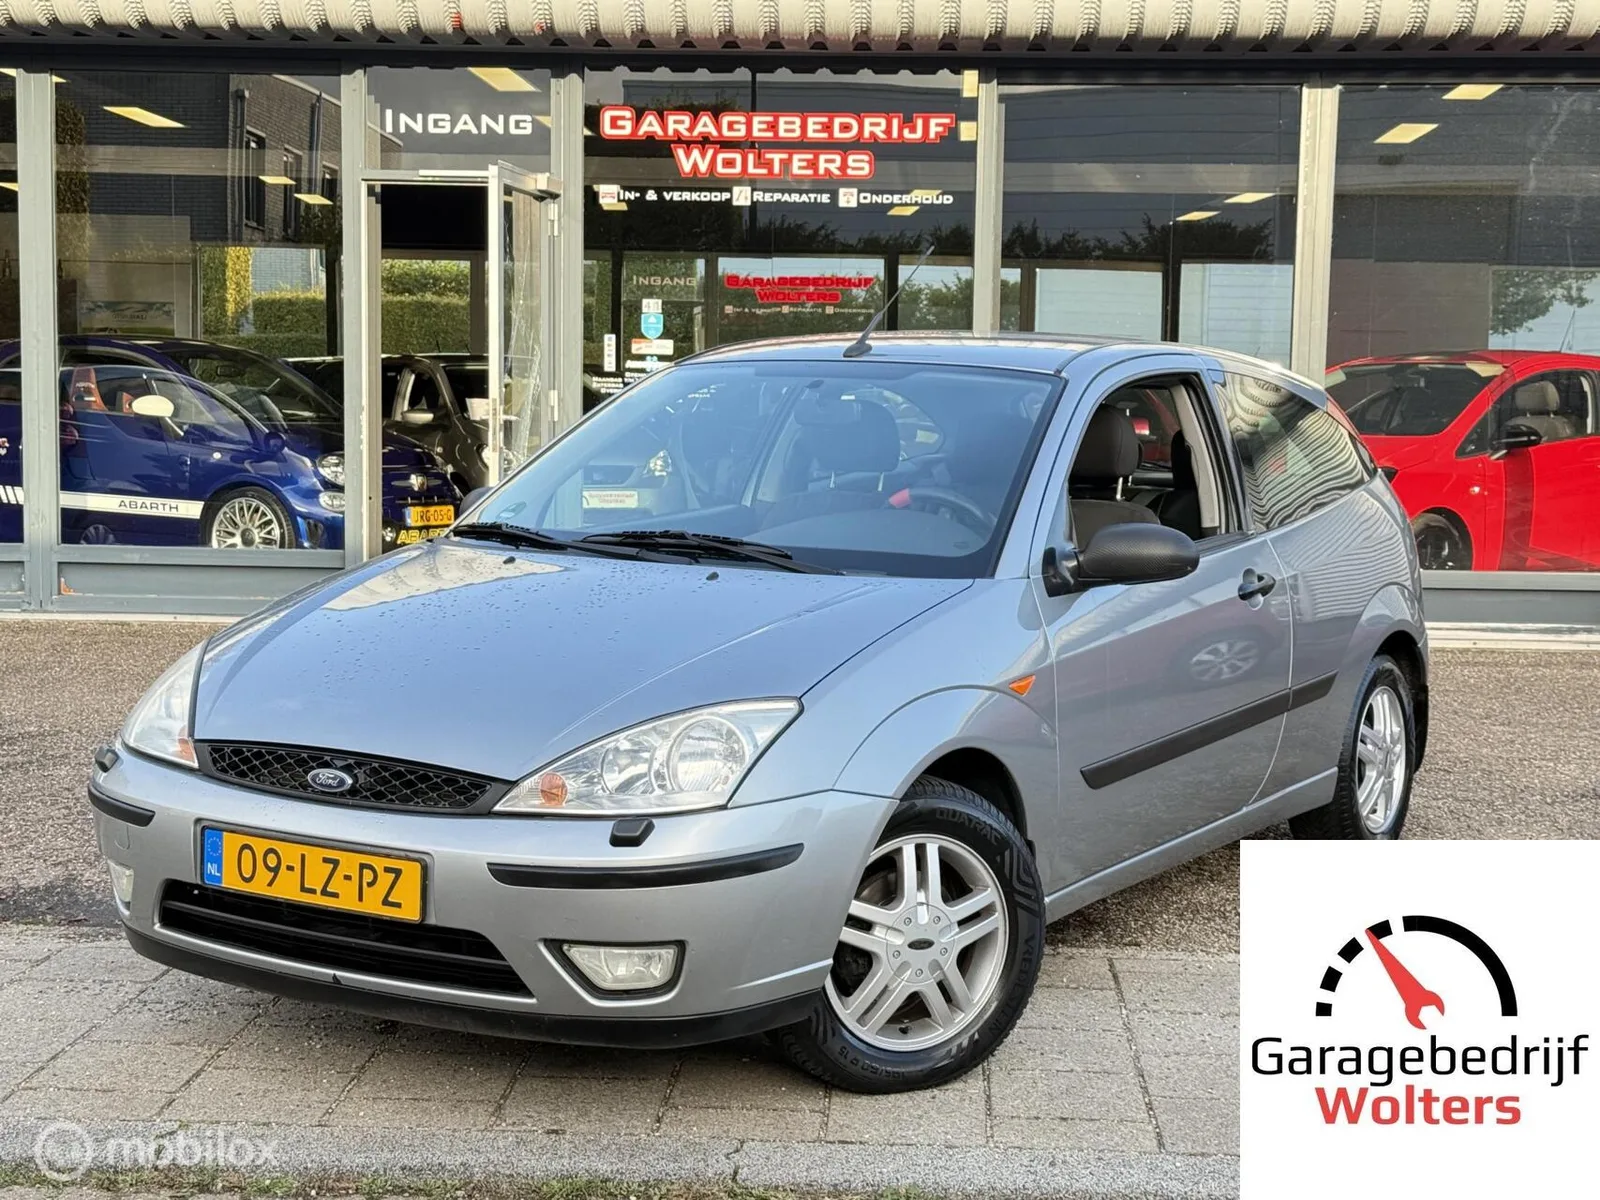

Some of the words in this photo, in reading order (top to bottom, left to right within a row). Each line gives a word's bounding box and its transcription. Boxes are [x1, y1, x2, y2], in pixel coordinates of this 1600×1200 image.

[385, 109, 533, 135] INGANG
[600, 105, 956, 142] GARAGEBEDRIJF
[671, 144, 874, 179] WOLTERS
[646, 190, 658, 200] &
[663, 191, 731, 202] VERKOOP
[753, 191, 831, 203] REPARATIE
[859, 192, 954, 204] ONDERHOUD
[118, 500, 179, 512] ABARTH
[315, 771, 341, 788] Ford
[207, 861, 221, 877] NL
[236, 842, 403, 909] 09-LZ-PZ
